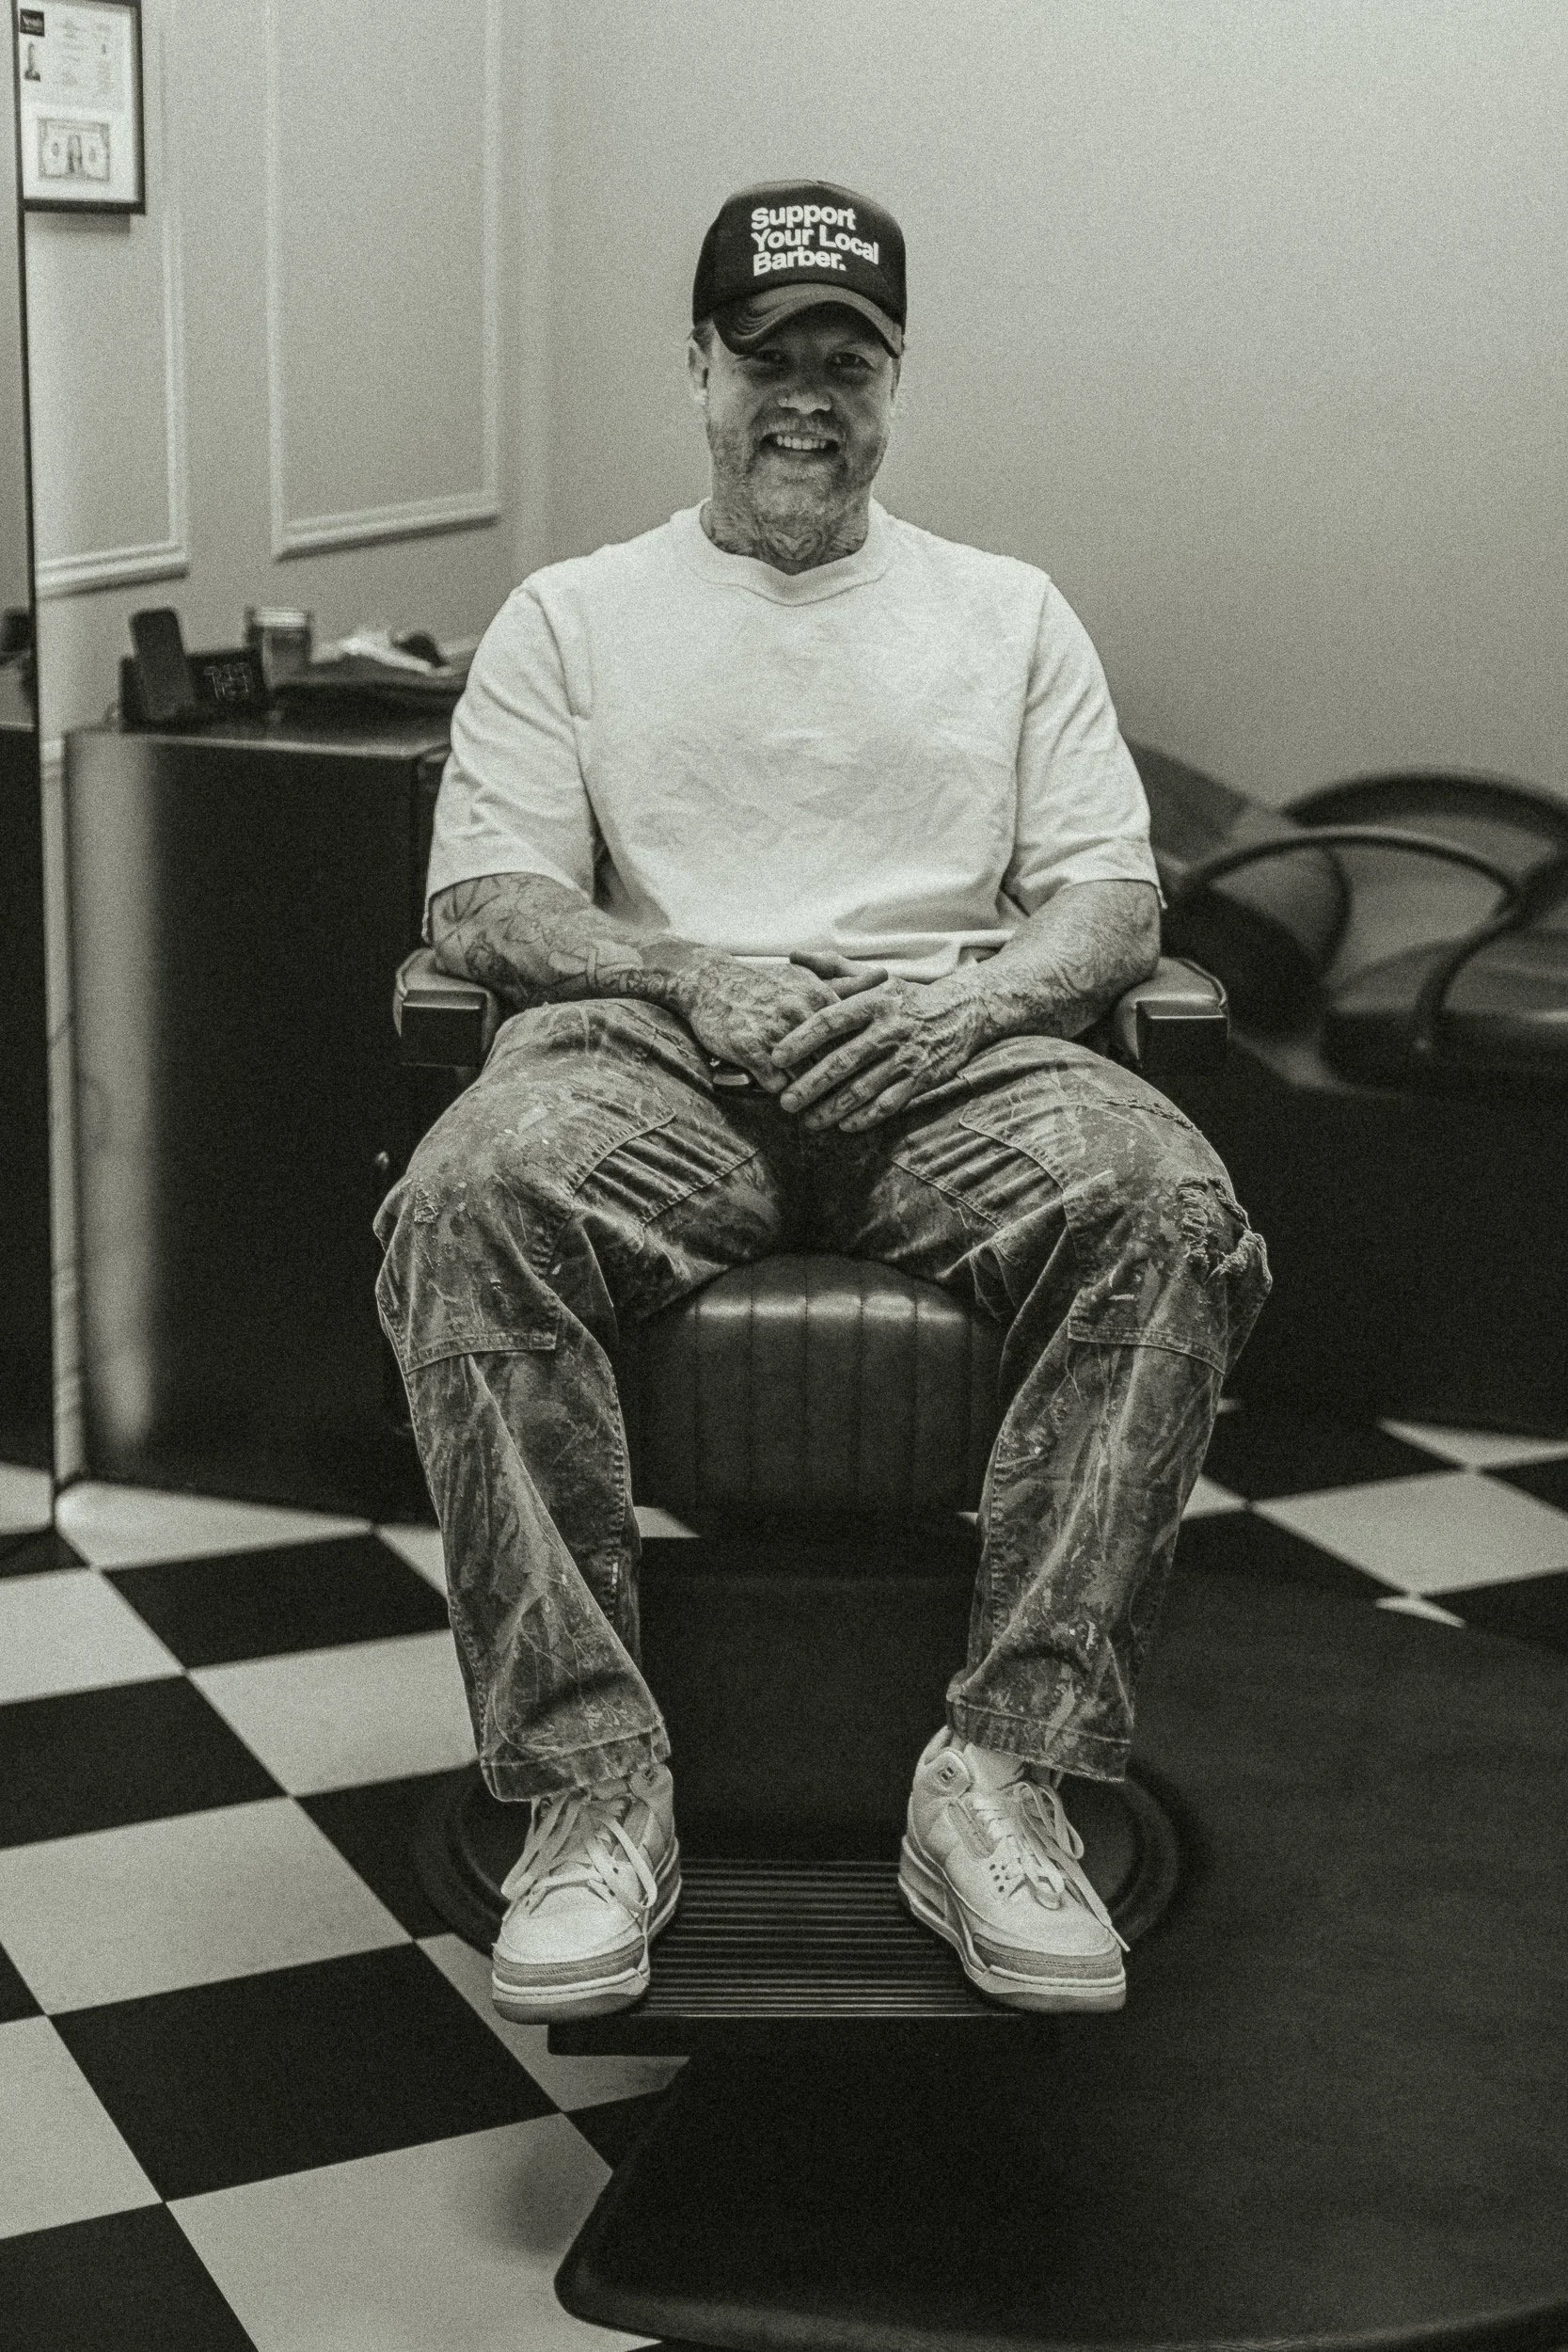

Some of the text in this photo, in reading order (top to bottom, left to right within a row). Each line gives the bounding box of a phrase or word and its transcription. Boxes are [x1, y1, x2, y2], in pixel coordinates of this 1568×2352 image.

[751, 204, 857, 230] Support
[751, 224, 879, 265] Your Local
[752, 246, 847, 277] Barber.
